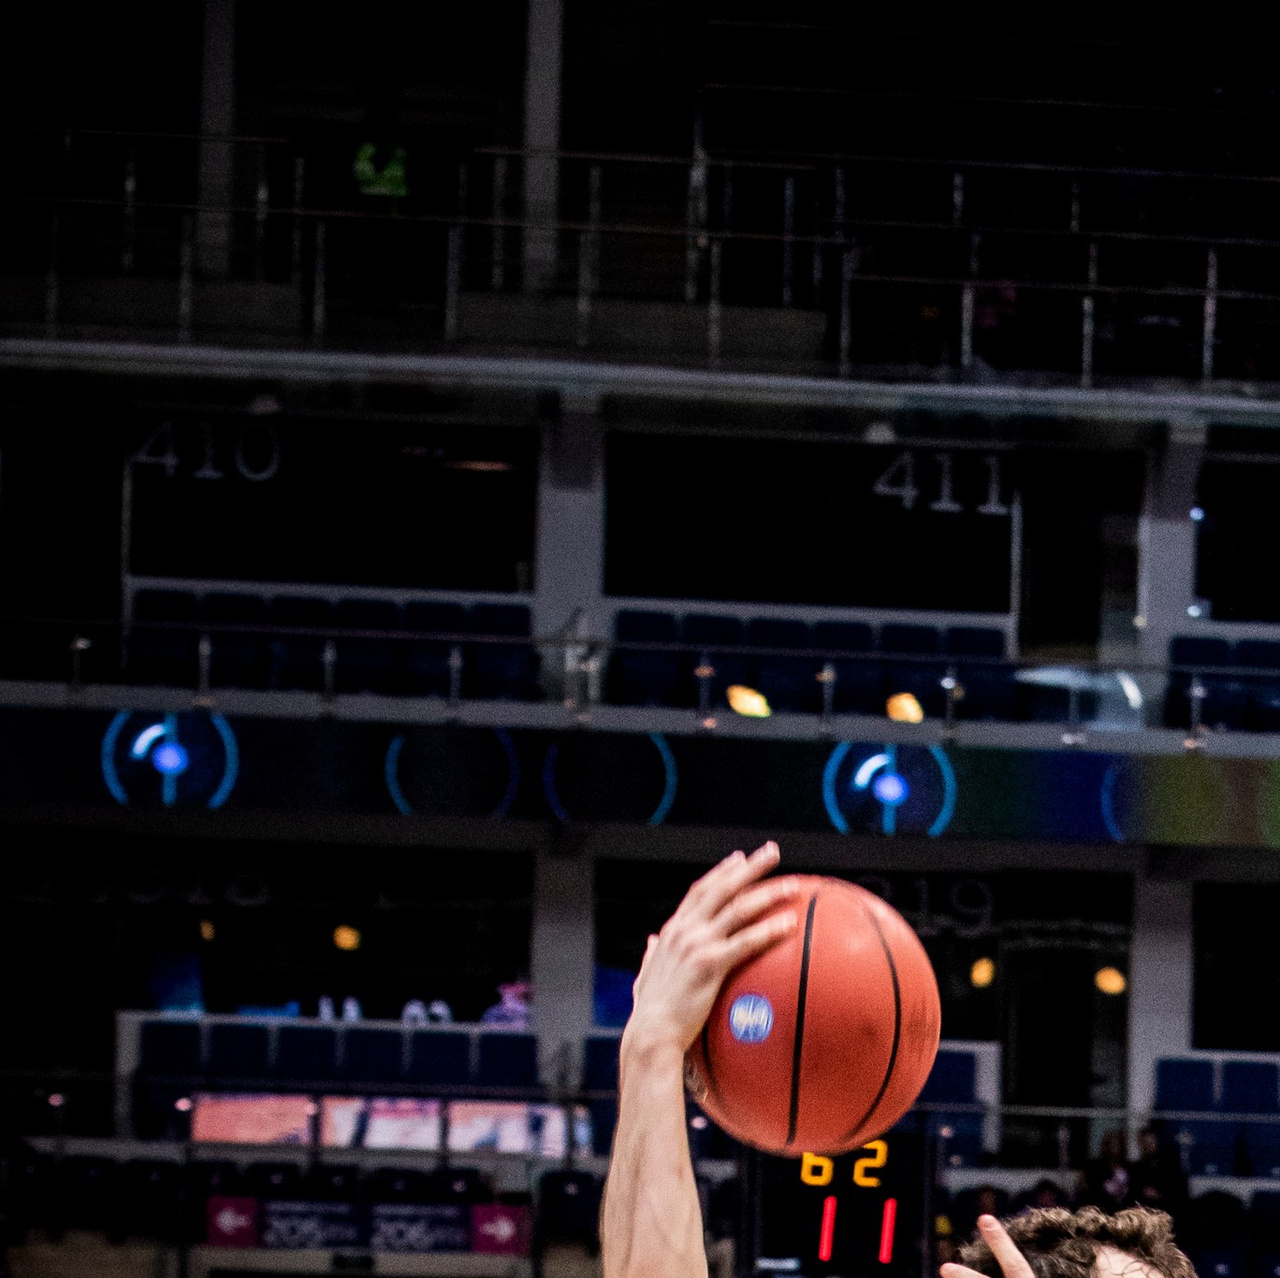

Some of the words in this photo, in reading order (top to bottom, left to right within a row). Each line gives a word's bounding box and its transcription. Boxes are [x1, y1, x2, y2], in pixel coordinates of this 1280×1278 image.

[128, 418, 284, 483] 410
[868, 450, 1011, 518] 411
[818, 1195, 897, 1264] 11
